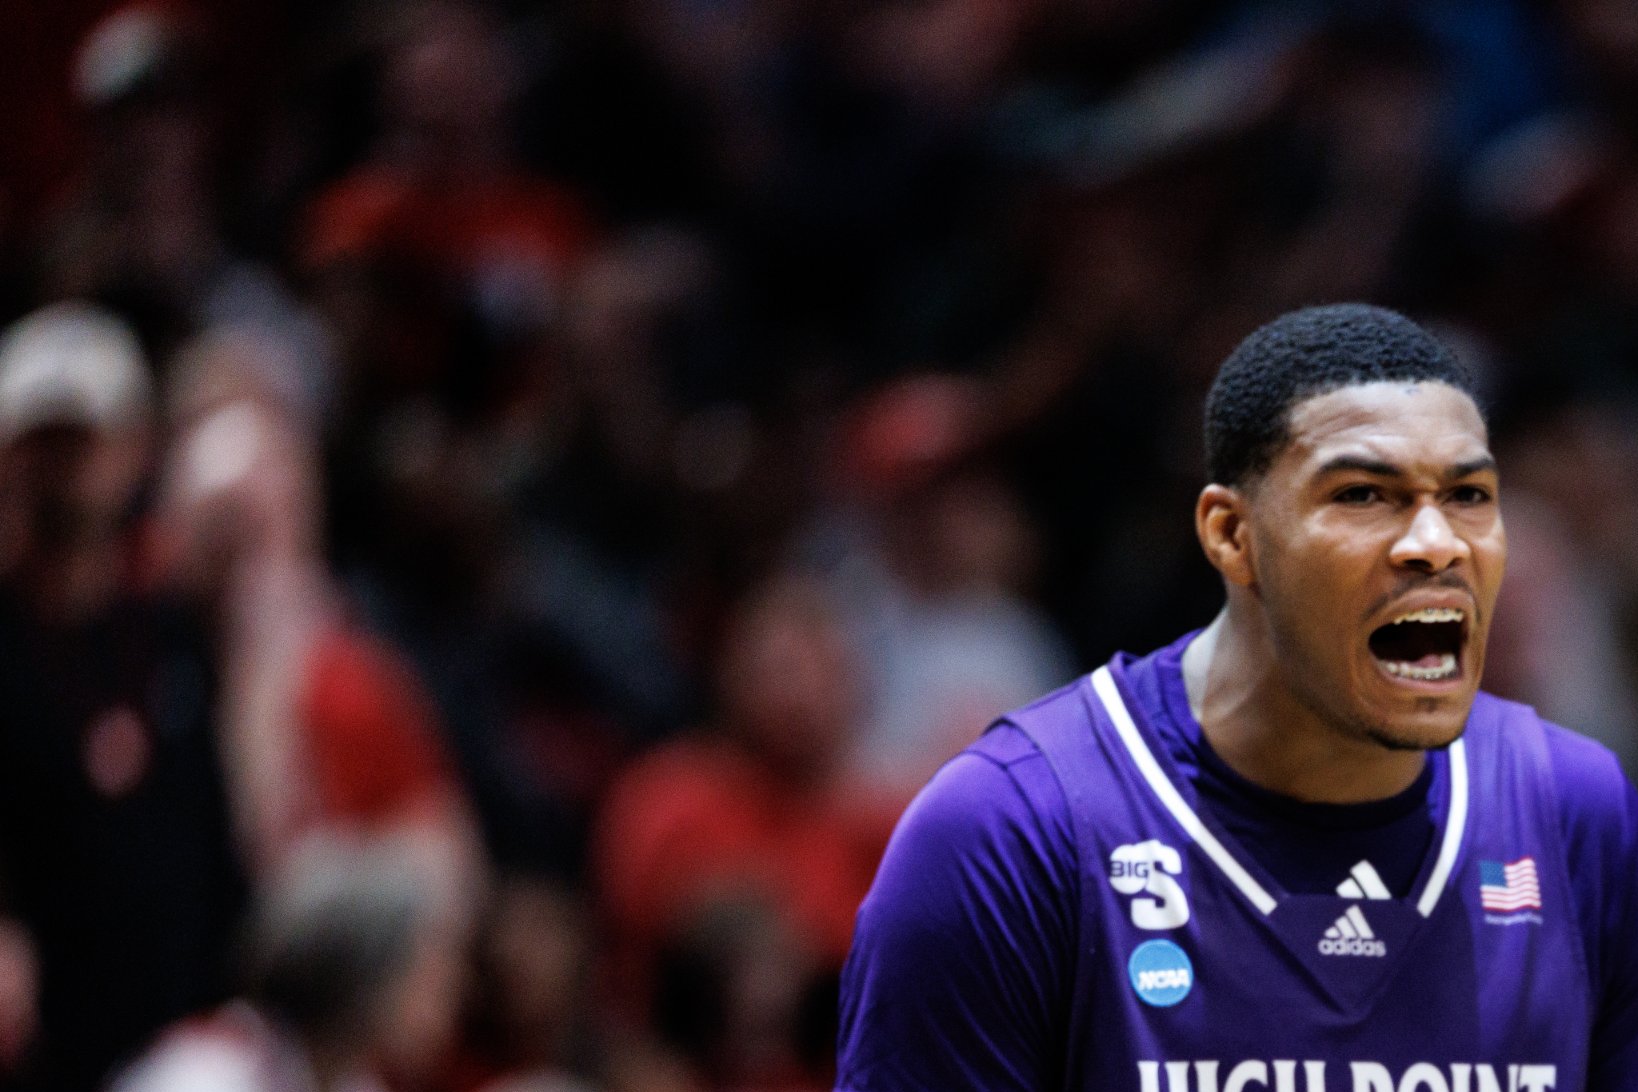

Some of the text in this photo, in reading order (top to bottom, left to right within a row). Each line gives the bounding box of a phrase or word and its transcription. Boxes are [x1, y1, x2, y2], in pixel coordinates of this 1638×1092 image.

[1110, 861, 1149, 877] BIG
[1318, 938, 1386, 956] adidas
[1139, 968, 1190, 990] NCAA
